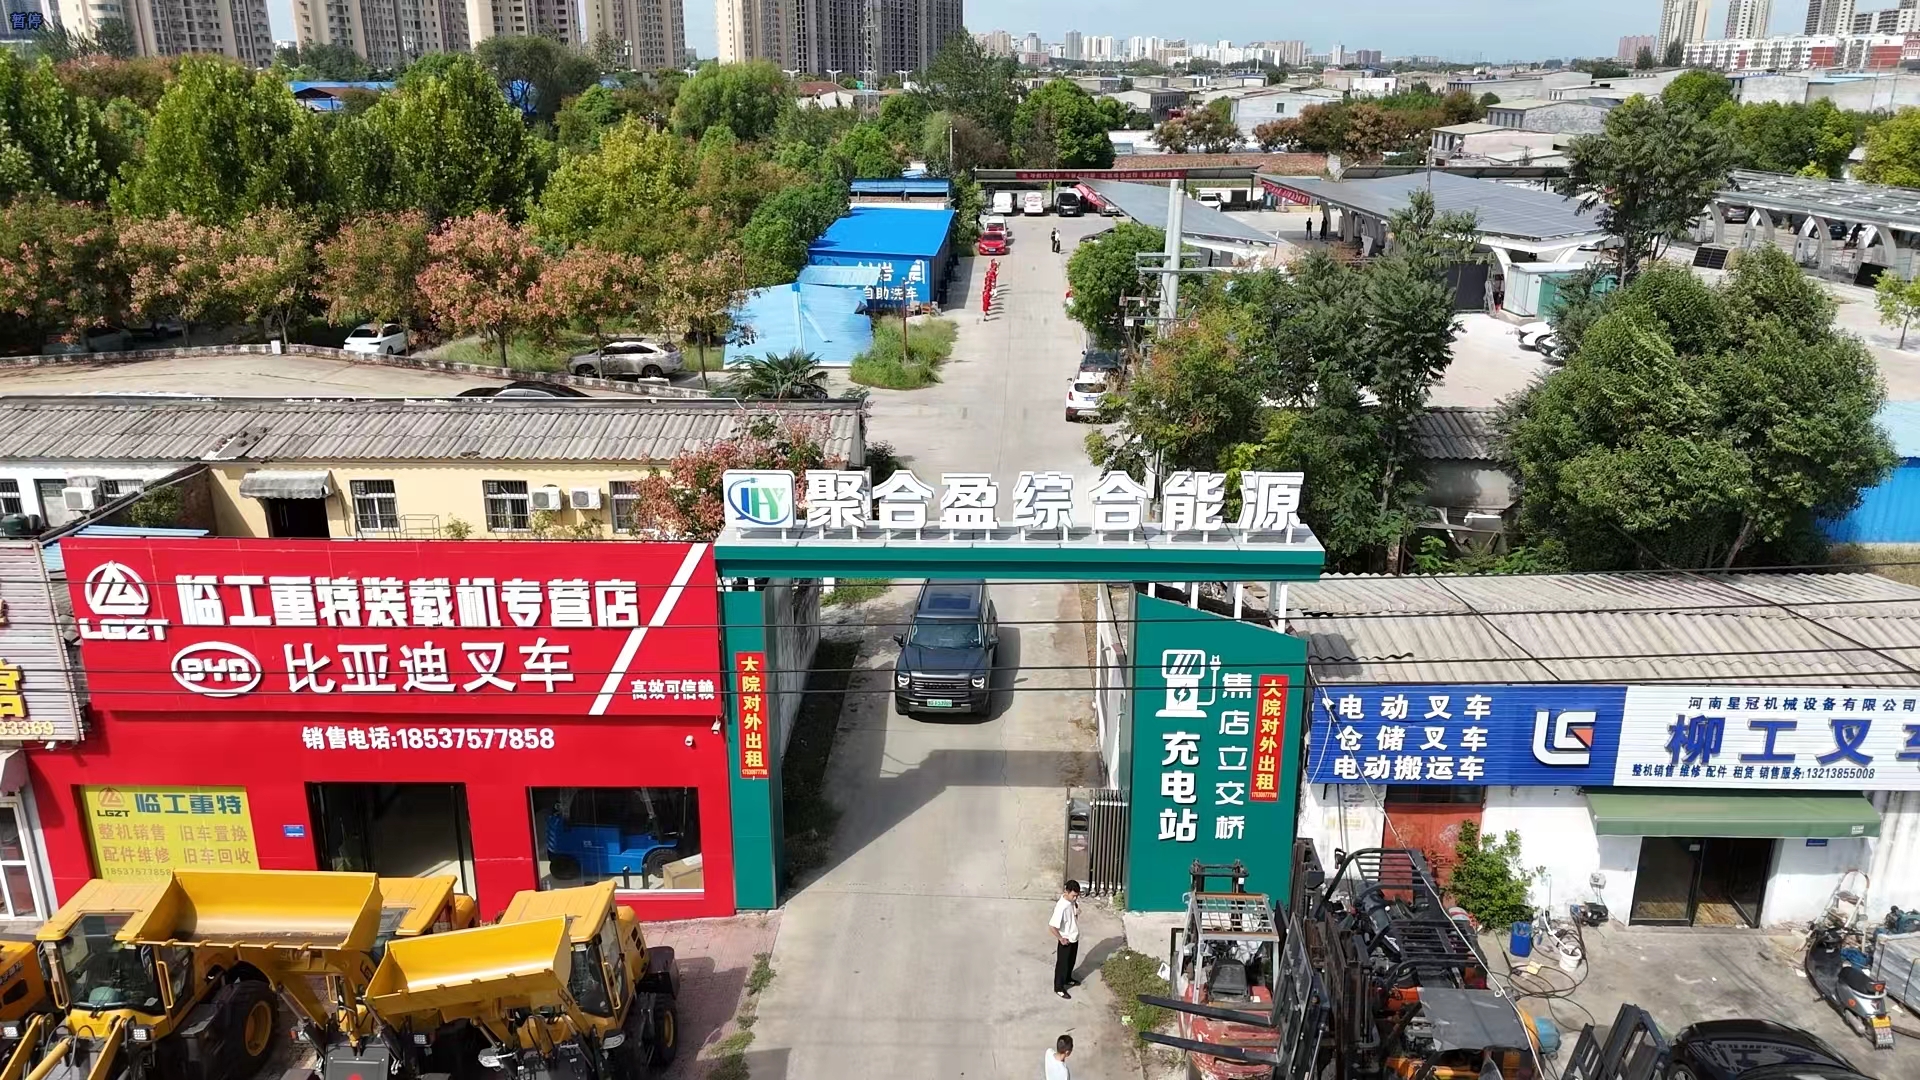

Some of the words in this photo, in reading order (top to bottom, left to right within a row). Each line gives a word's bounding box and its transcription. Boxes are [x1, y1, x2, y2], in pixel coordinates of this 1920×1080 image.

[863, 286, 919, 300] 自助洗车
[805, 470, 1305, 531] 聚合盈综合能源
[175, 575, 640, 628] 临工重特装载机专营店
[78, 618, 169, 641] LGZT
[180, 658, 252, 682] BYD
[283, 637, 575, 693] 比亚迪叉车
[631, 679, 715, 700] 高效可信赖
[741, 656, 763, 767] 大院对外出租
[1338, 694, 1492, 720] 电动叉车
[1689, 696, 1916, 712] 河南星冠机械设备有限公司
[302, 726, 555, 749] 销售电话:18537577858
[1255, 679, 1283, 791] 大院对外出租
[1335, 725, 1489, 752] 仓储叉车
[1214, 673, 1253, 840] 焦店立交桥
[1334, 755, 1485, 781] 电动搬运车
[1632, 764, 1675, 778] 整机销售
[1680, 765, 1701, 778] 维修
[1706, 766, 1727, 779] 配件
[1733, 766, 1754, 779] 租赁
[1158, 732, 1201, 842] 充电站
[97, 809, 130, 817] LGZT
[134, 793, 242, 815] 临工重特
[98, 823, 166, 841] 整机销售
[180, 824, 248, 842] 旧车置换
[102, 846, 171, 864] 配件维修
[184, 847, 251, 865] 旧车回收
